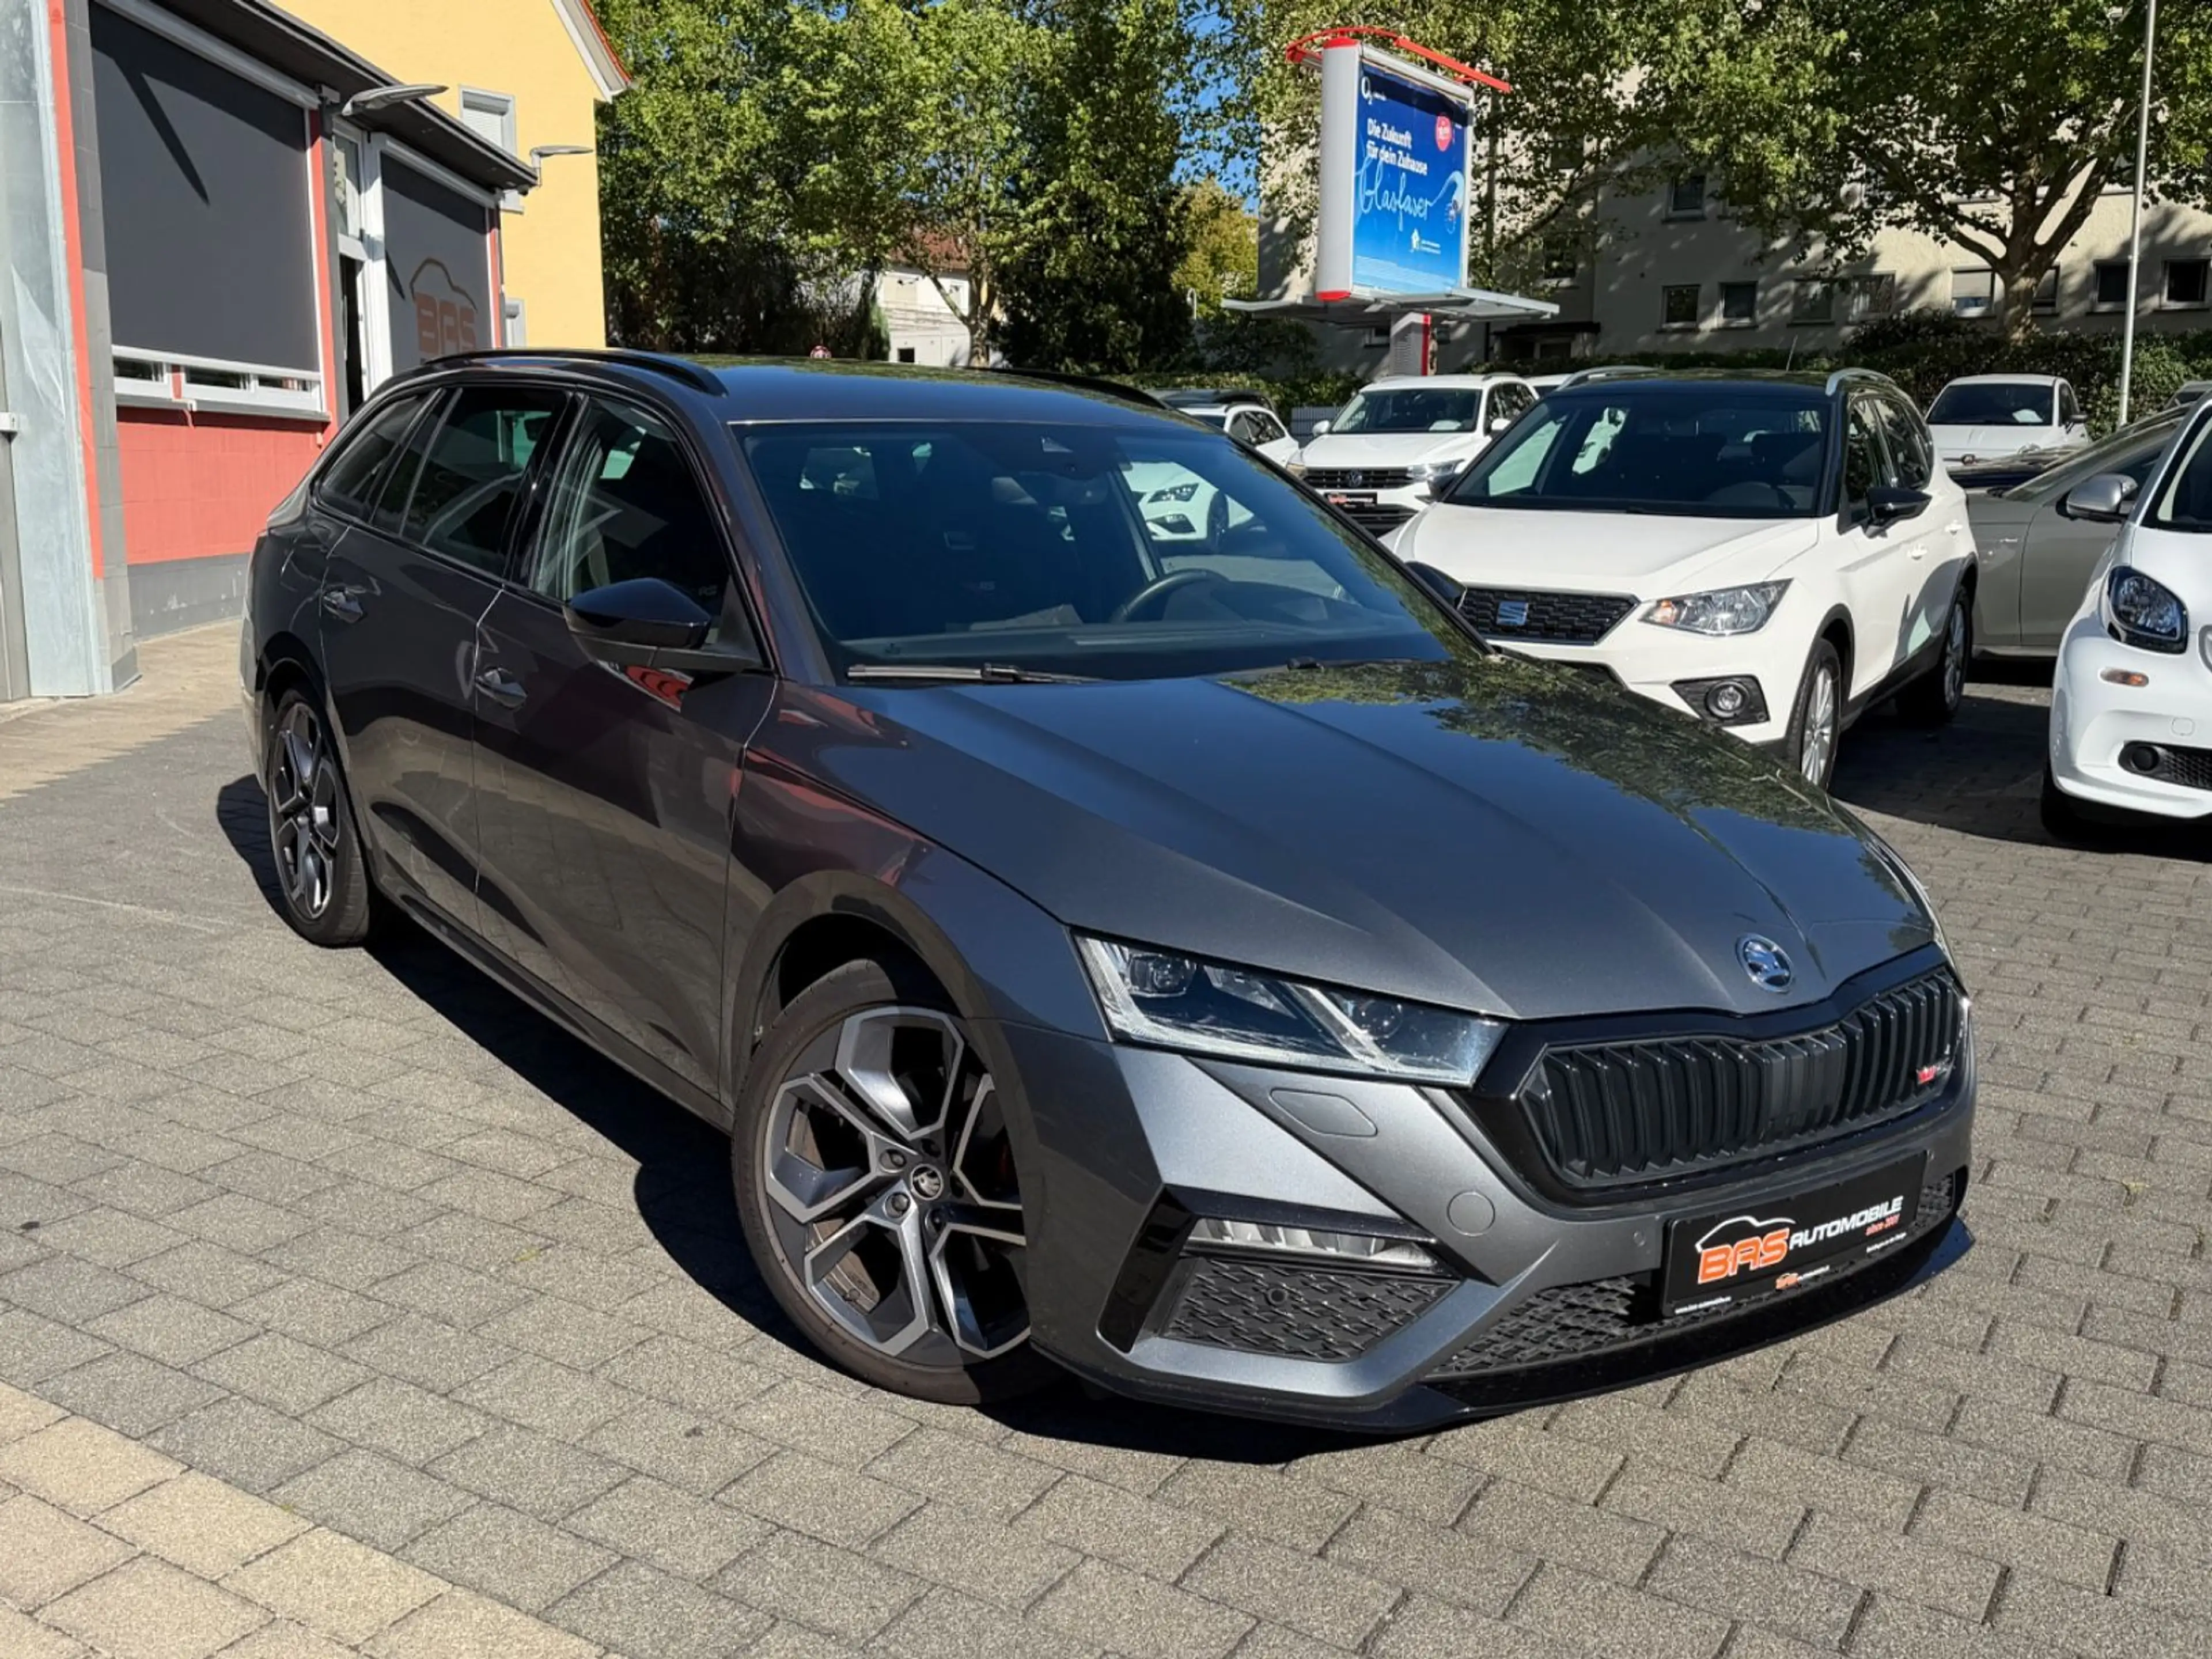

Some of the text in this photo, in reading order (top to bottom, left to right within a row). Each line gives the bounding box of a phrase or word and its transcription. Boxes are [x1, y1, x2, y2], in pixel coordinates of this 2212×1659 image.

[1367, 117, 1381, 138] Die
[1382, 122, 1412, 150] Zukunft
[1378, 145, 1397, 165] dein
[1697, 1195, 1904, 1284] BAS AUTOMOBILE
